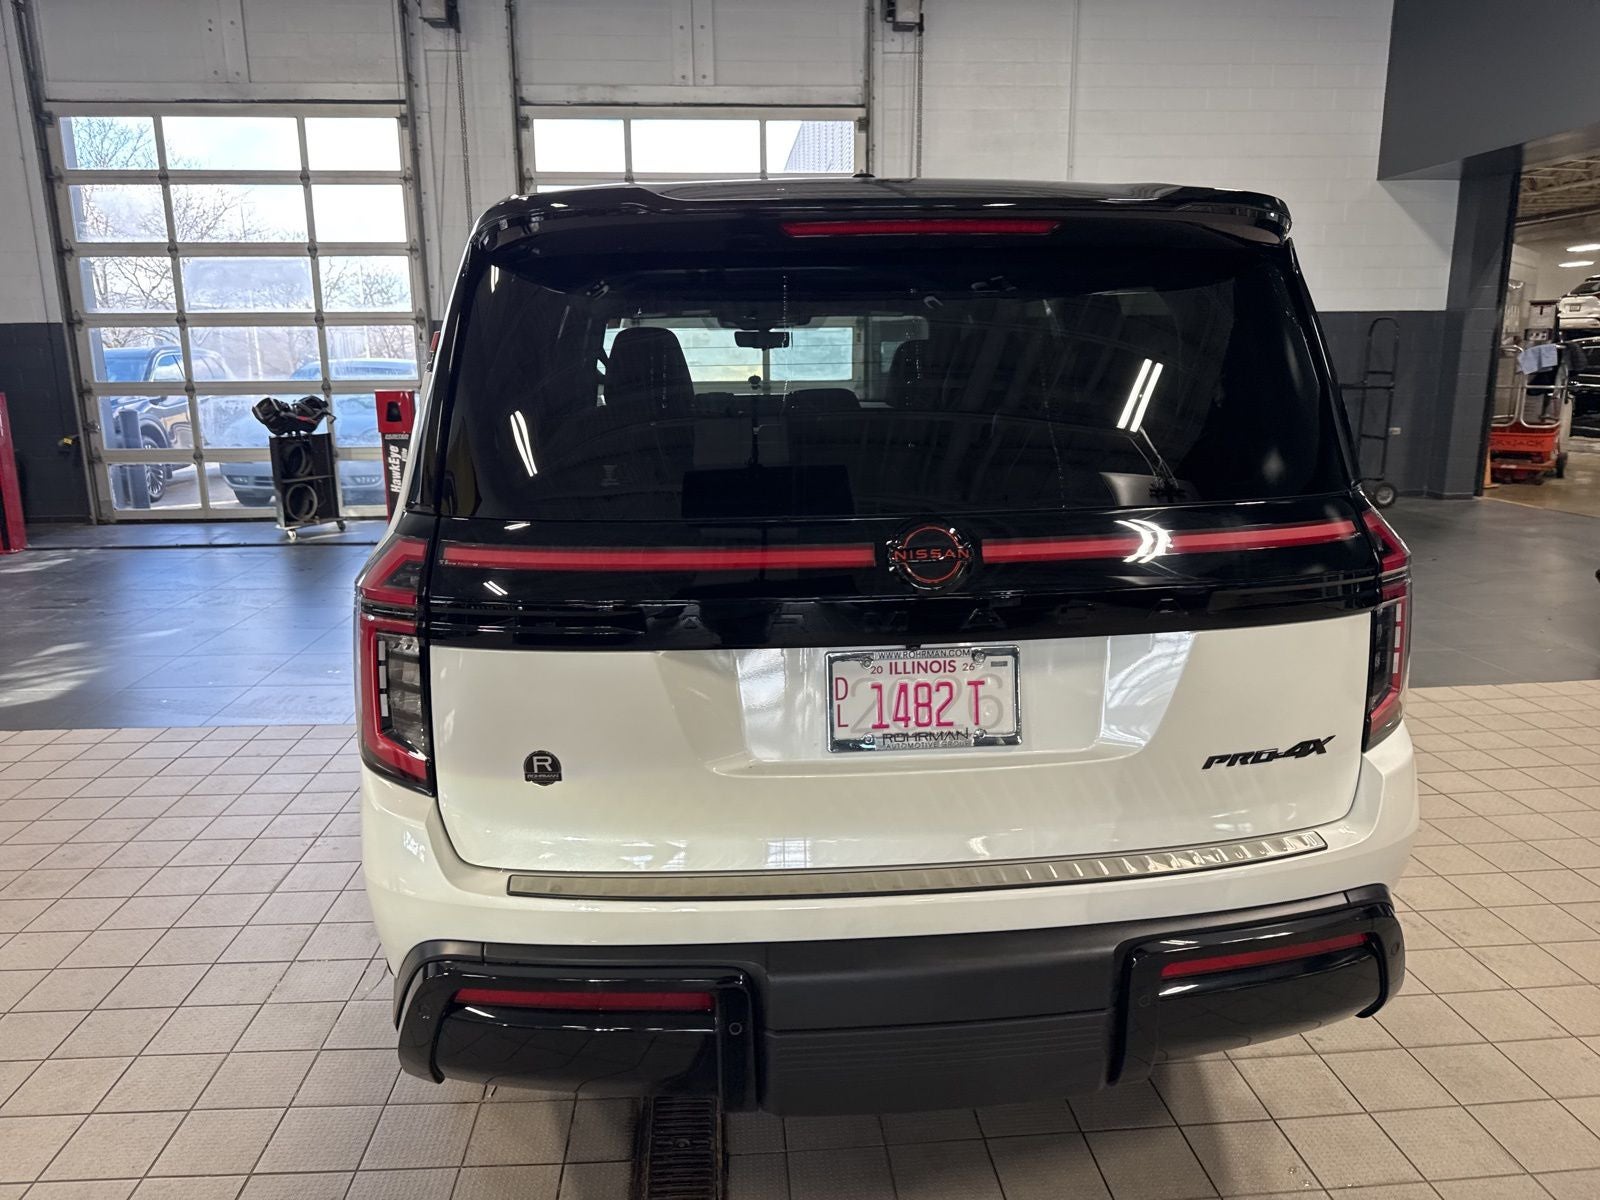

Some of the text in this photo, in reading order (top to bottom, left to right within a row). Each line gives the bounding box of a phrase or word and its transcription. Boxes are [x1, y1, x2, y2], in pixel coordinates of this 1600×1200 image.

[388, 445, 402, 492] HawkEye
[893, 549, 969, 560] NISSAN
[878, 649, 971, 660] WWW.ROHRMAN.COM
[871, 660, 976, 675] 20 ILLINOIS 26
[870, 681, 985, 729] 1482 T
[883, 728, 969, 744] ROHRMAN
[1202, 735, 1336, 769] PRO-4X
[532, 756, 552, 773] R
